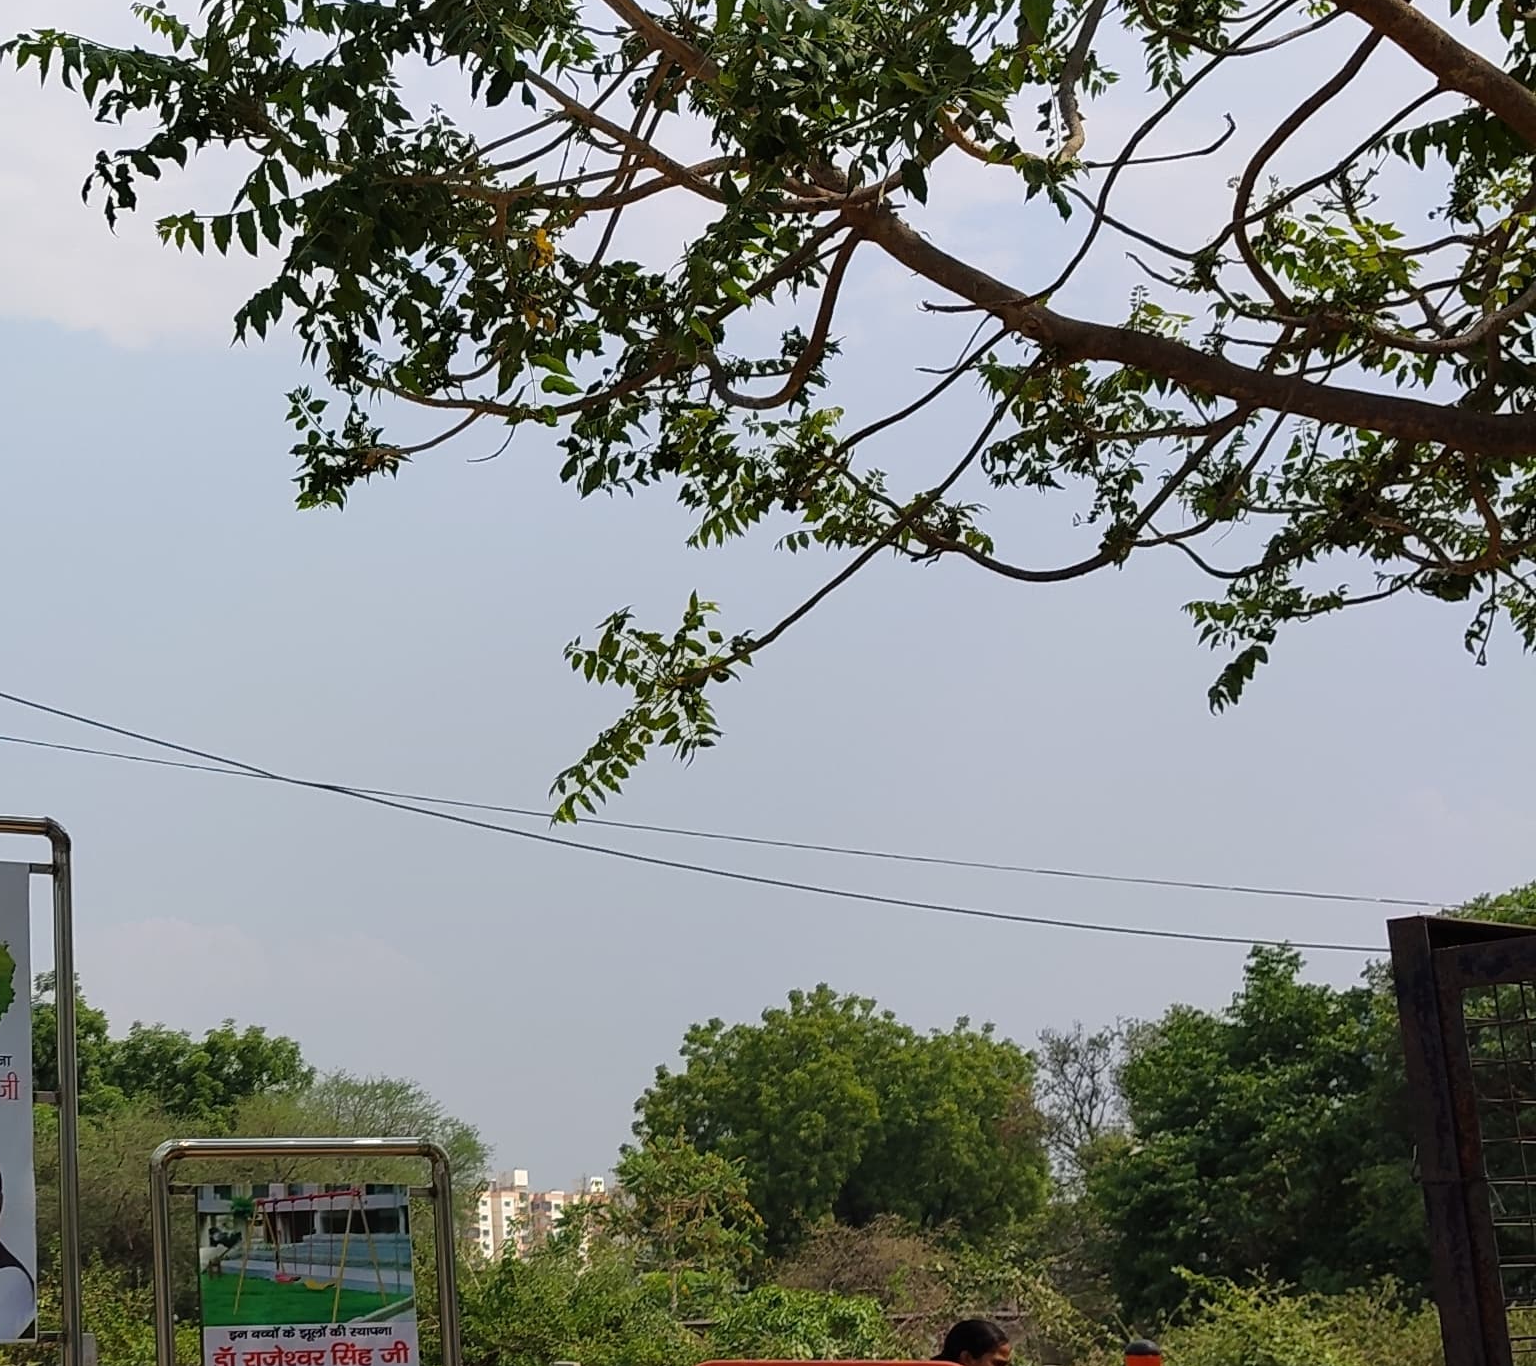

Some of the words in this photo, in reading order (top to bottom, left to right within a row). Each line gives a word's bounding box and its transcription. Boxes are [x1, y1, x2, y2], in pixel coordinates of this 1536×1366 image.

[228, 1330, 248, 1341] इन
[282, 1325, 296, 1338] के
[299, 1325, 328, 1342] झूलों
[329, 1324, 346, 1337] की
[349, 1327, 392, 1337] स्थापना
[330, 1342, 375, 1366] सिंह
[378, 1340, 410, 1364] जी
